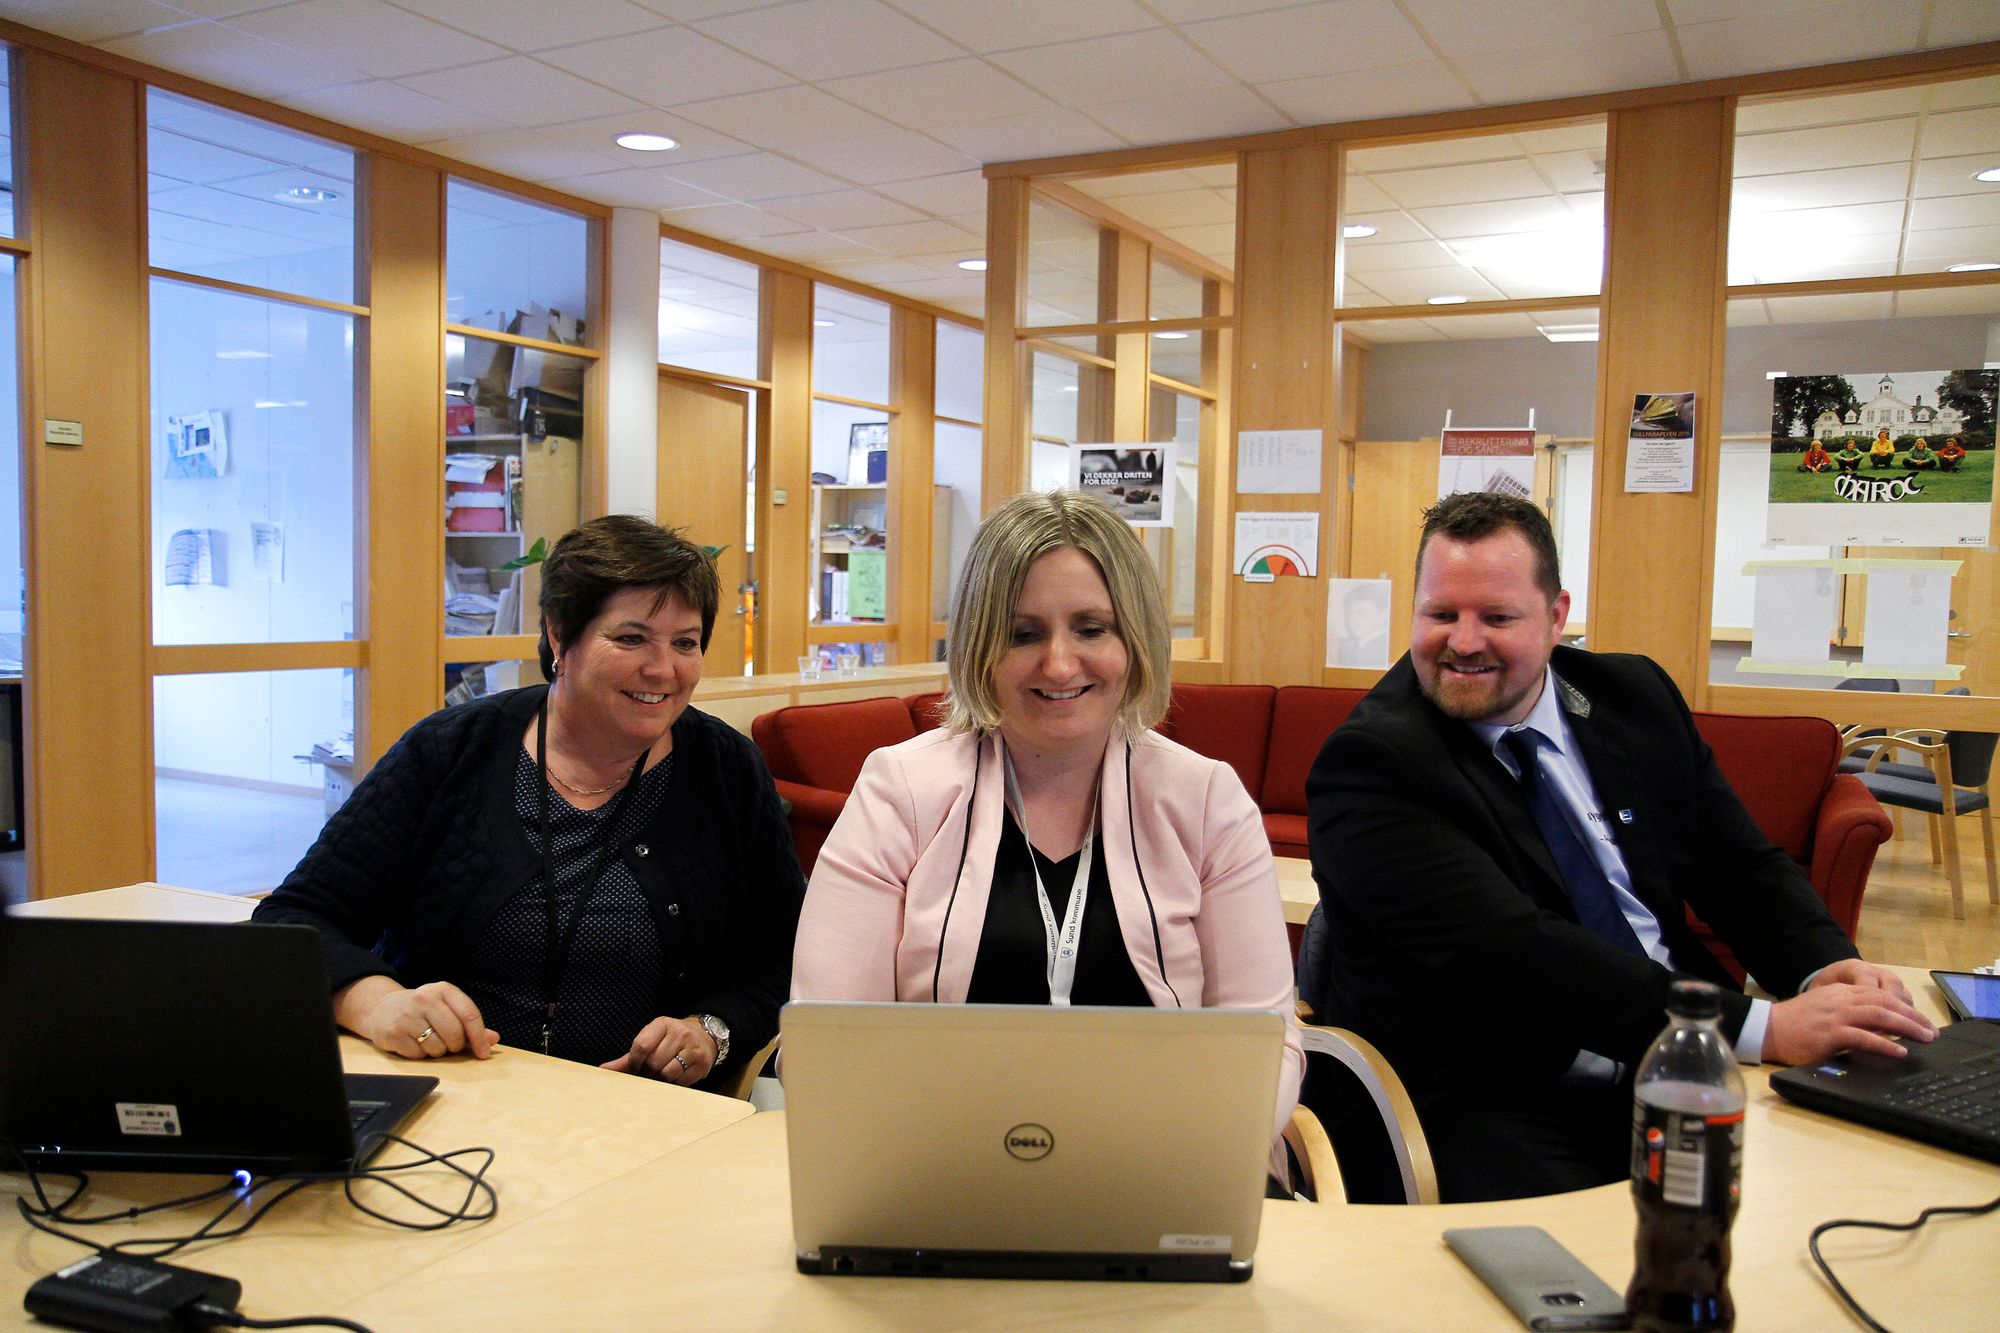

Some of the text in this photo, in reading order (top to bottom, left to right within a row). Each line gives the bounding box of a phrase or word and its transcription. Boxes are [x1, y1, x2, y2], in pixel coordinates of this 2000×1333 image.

[1458, 437, 1529, 447] REKRUTTERING
[1458, 446, 1473, 455] OG
[1066, 888, 1082, 944] Sund kommune
[1009, 1137, 1049, 1148] DELL
